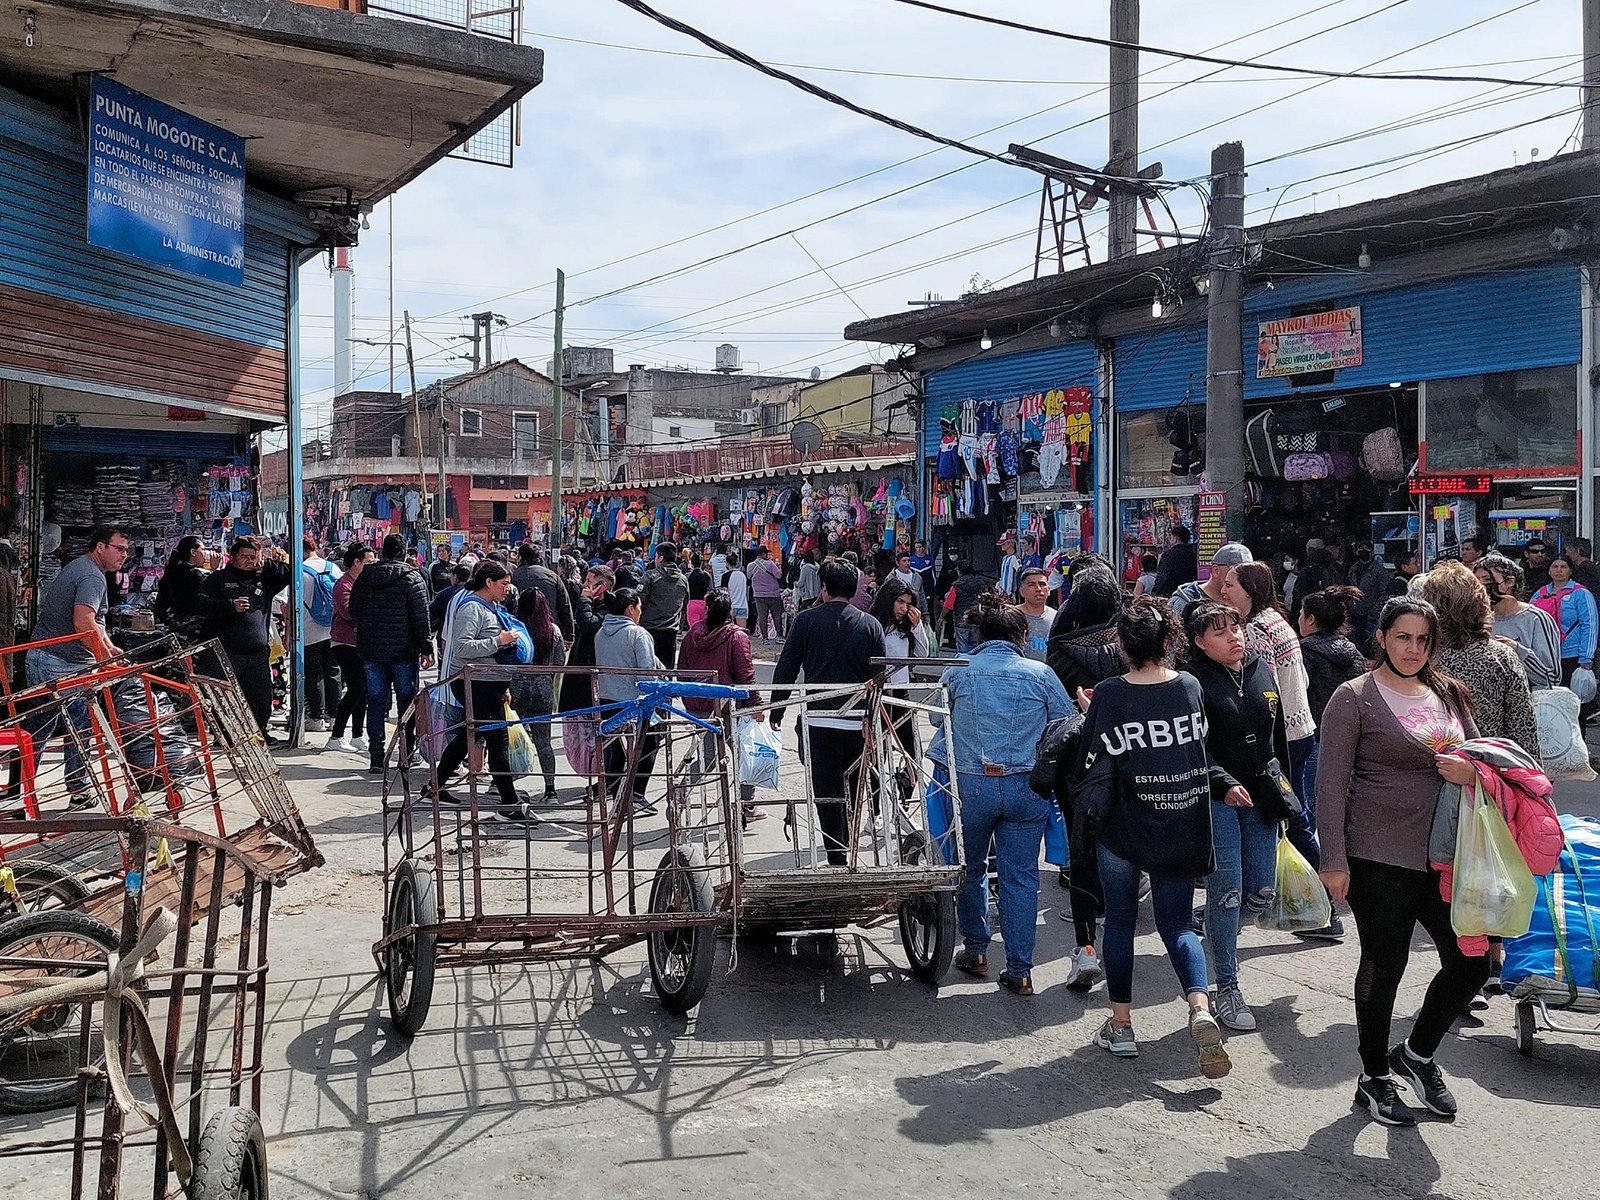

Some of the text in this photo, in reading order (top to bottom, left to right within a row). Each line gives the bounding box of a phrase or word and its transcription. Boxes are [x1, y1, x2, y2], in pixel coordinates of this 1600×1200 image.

[96, 94, 242, 169] PUNTA MOGOTE S.C.A.
[94, 139, 242, 204] LOCATARIOS QUE SE ENCUENTRA PROHIBIDO
[95, 123, 141, 151] COMUNICA
[144, 143, 151, 155] A
[154, 146, 168, 161] LOS
[171, 153, 205, 175] SEÑORES
[208, 167, 235, 186] SOCIOS
[94, 188, 128, 209] MARCAS
[128, 200, 143, 214] (LEY
[94, 172, 241, 232] DE MERCADERÍA EN INFRACCIÓN A LA LEY DE
[95, 156, 242, 219] EN TODO EL PASEO DE COMPRAS, LA VENTA
[162, 236, 242, 270] LA ADMINISTRACIÓN
[1267, 317, 1308, 336] MAYKOL
[1311, 309, 1353, 328] MEDIAS
[1275, 356, 1293, 367] PASEO
[1325, 399, 1344, 410] SALIDA
[1154, 801, 1188, 810] LONDON
